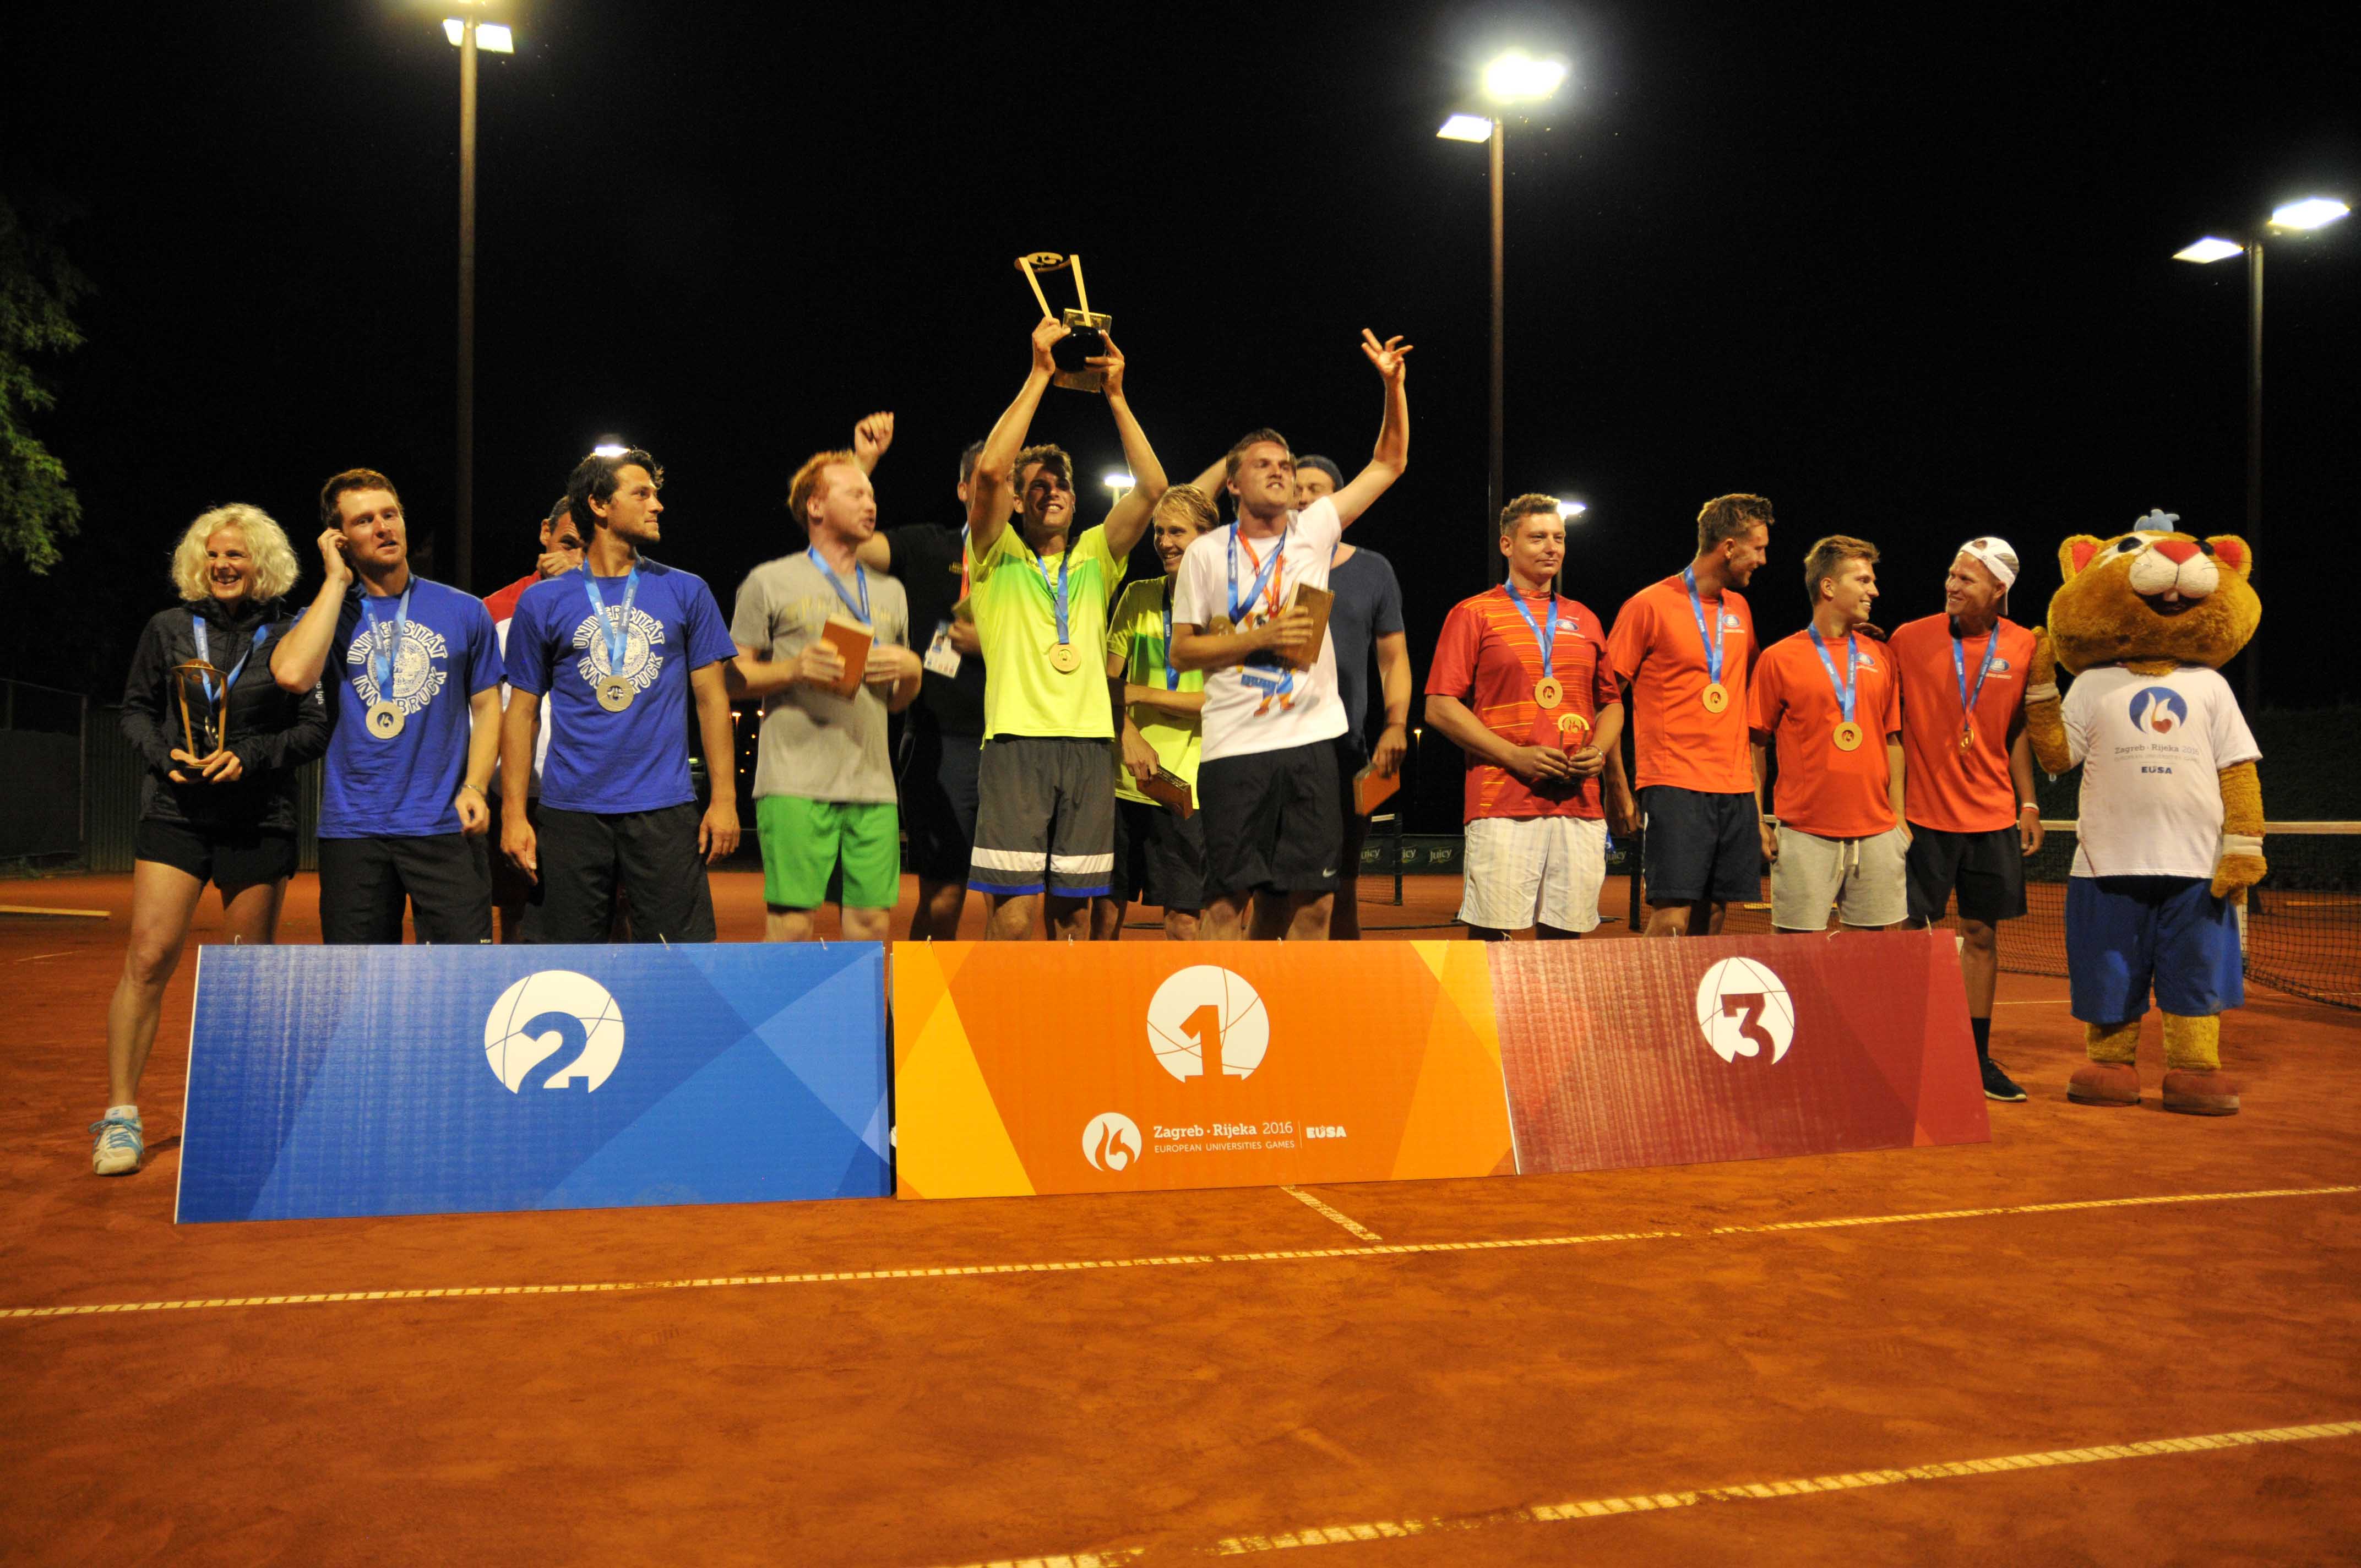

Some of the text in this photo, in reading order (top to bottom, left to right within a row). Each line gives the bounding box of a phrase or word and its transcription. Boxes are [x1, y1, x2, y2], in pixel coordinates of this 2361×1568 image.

[577, 651, 664, 695] INNRUCK
[352, 666, 448, 716] INNBRUCK
[2114, 744, 2145, 755] Zagreb
[2151, 744, 2179, 753] Rijeka
[2141, 766, 2172, 774] EUSA
[1179, 1005, 1242, 1082] 1
[1720, 993, 1776, 1064] 3
[517, 1011, 589, 1094] 2
[1154, 1121, 1293, 1140] Zagreb Rijeka 2016
[1305, 1125, 1347, 1139] EUSA
[1155, 1140, 1295, 1153] EUROPEAN UNIVERSITIES GAMES
